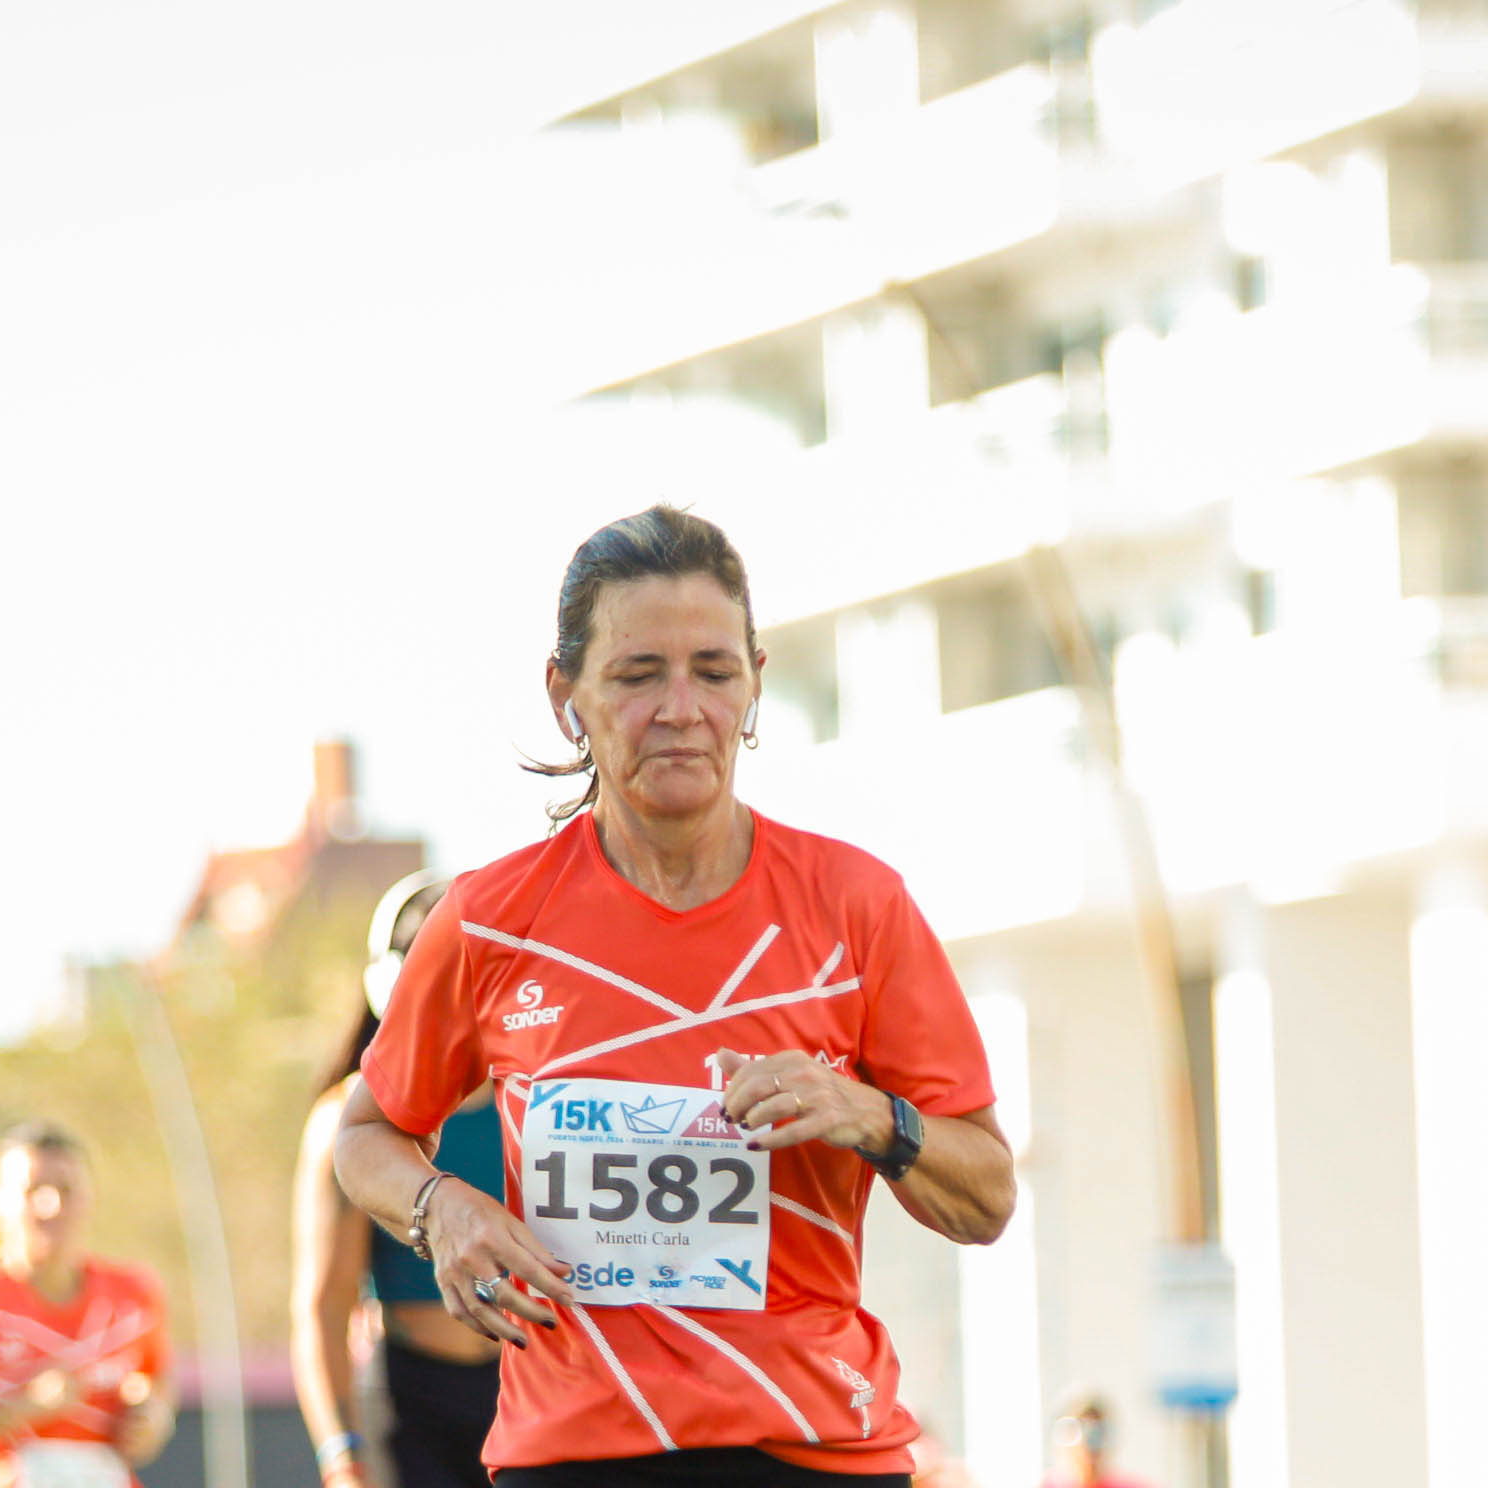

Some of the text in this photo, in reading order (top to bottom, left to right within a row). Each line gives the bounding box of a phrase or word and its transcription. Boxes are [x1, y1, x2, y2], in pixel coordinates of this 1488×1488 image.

[550, 1100, 613, 1132] 15K
[696, 1117, 729, 1134] 15K
[535, 1151, 759, 1224] 1582
[596, 1231, 690, 1246] Minetti Carla
